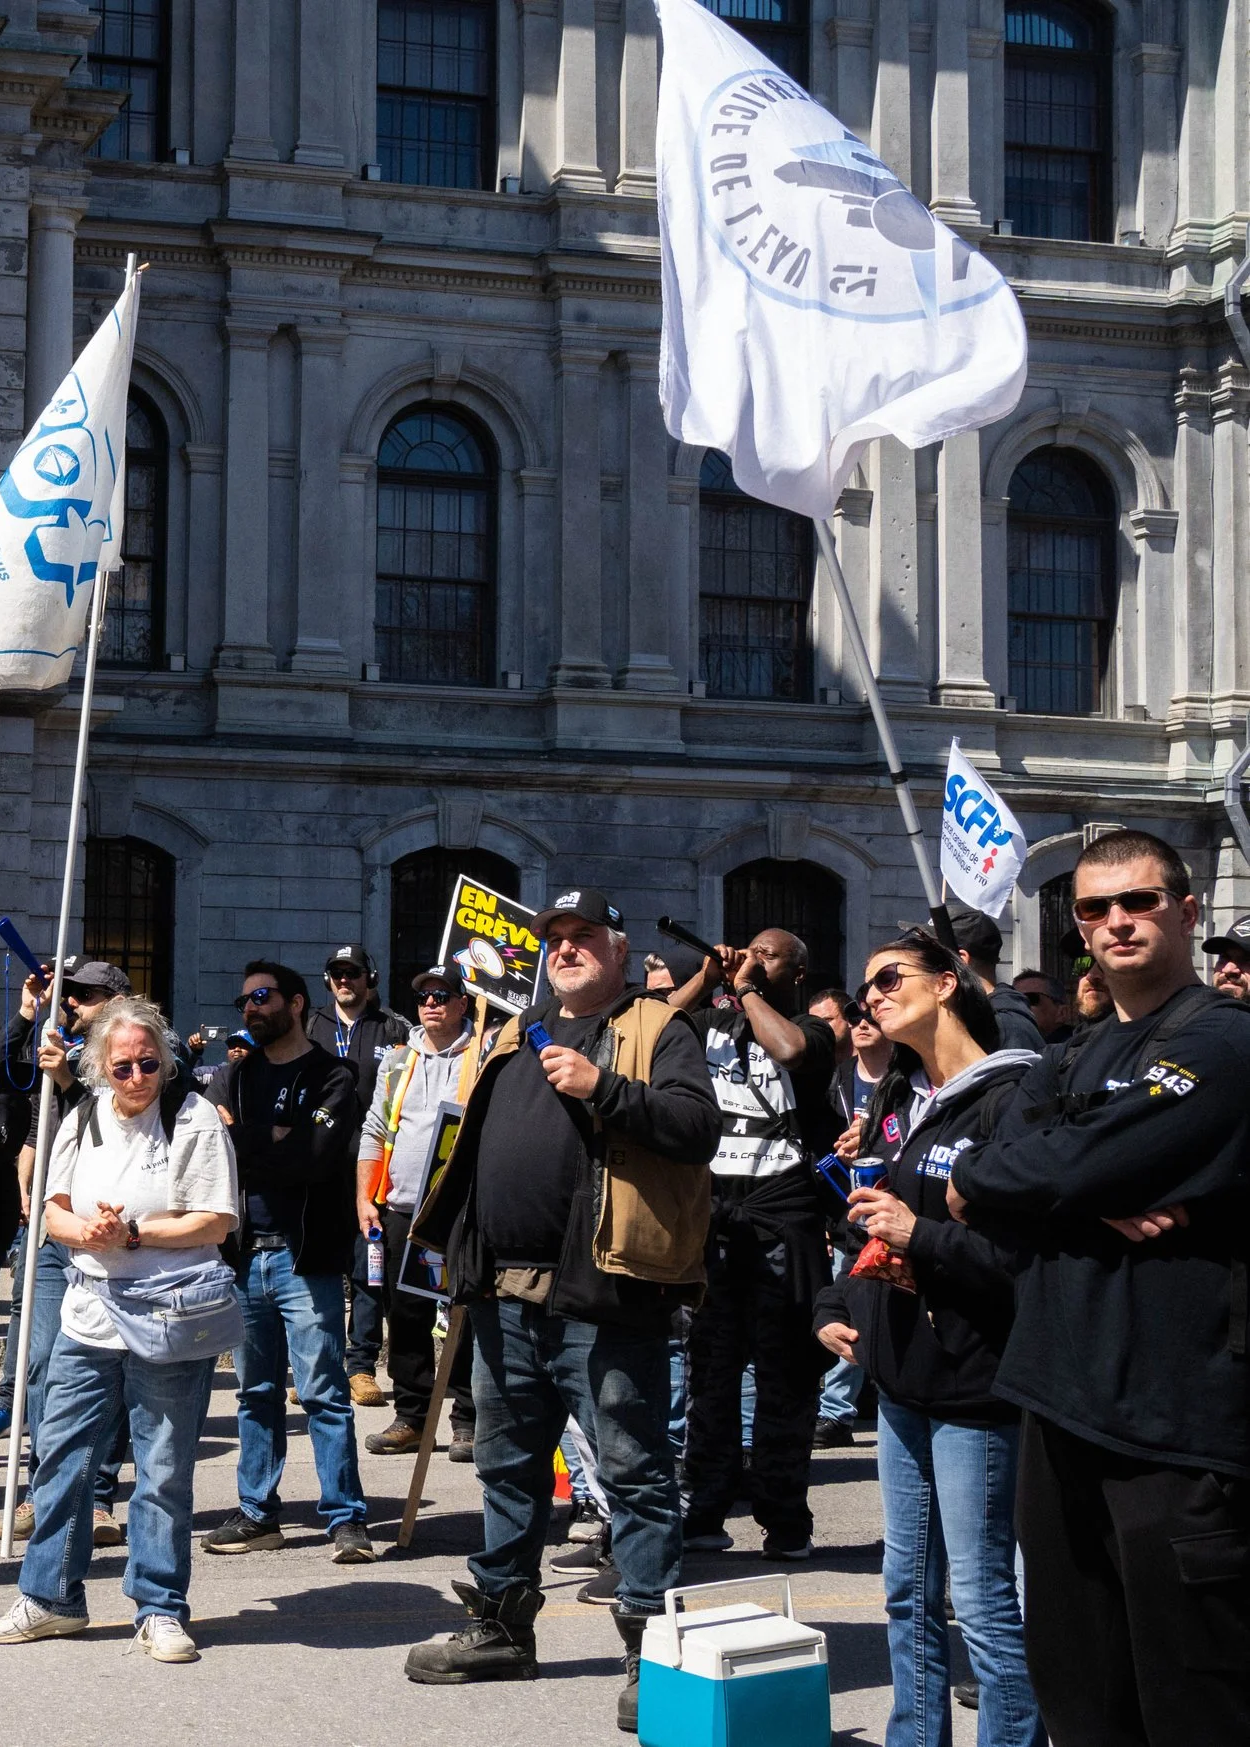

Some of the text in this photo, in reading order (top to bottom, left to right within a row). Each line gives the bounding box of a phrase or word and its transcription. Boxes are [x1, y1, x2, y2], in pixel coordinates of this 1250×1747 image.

[943, 774, 1014, 849] SCFP
[969, 853, 979, 865] de
[974, 873, 988, 887] FTQ
[460, 885, 498, 914] EN
[456, 907, 541, 953] GRÈVE
[1143, 1065, 1195, 1097] 1943
[311, 1109, 335, 1128] 1943
[741, 1152, 794, 1161] CASTLES
[916, 1162, 937, 1174] CLS
